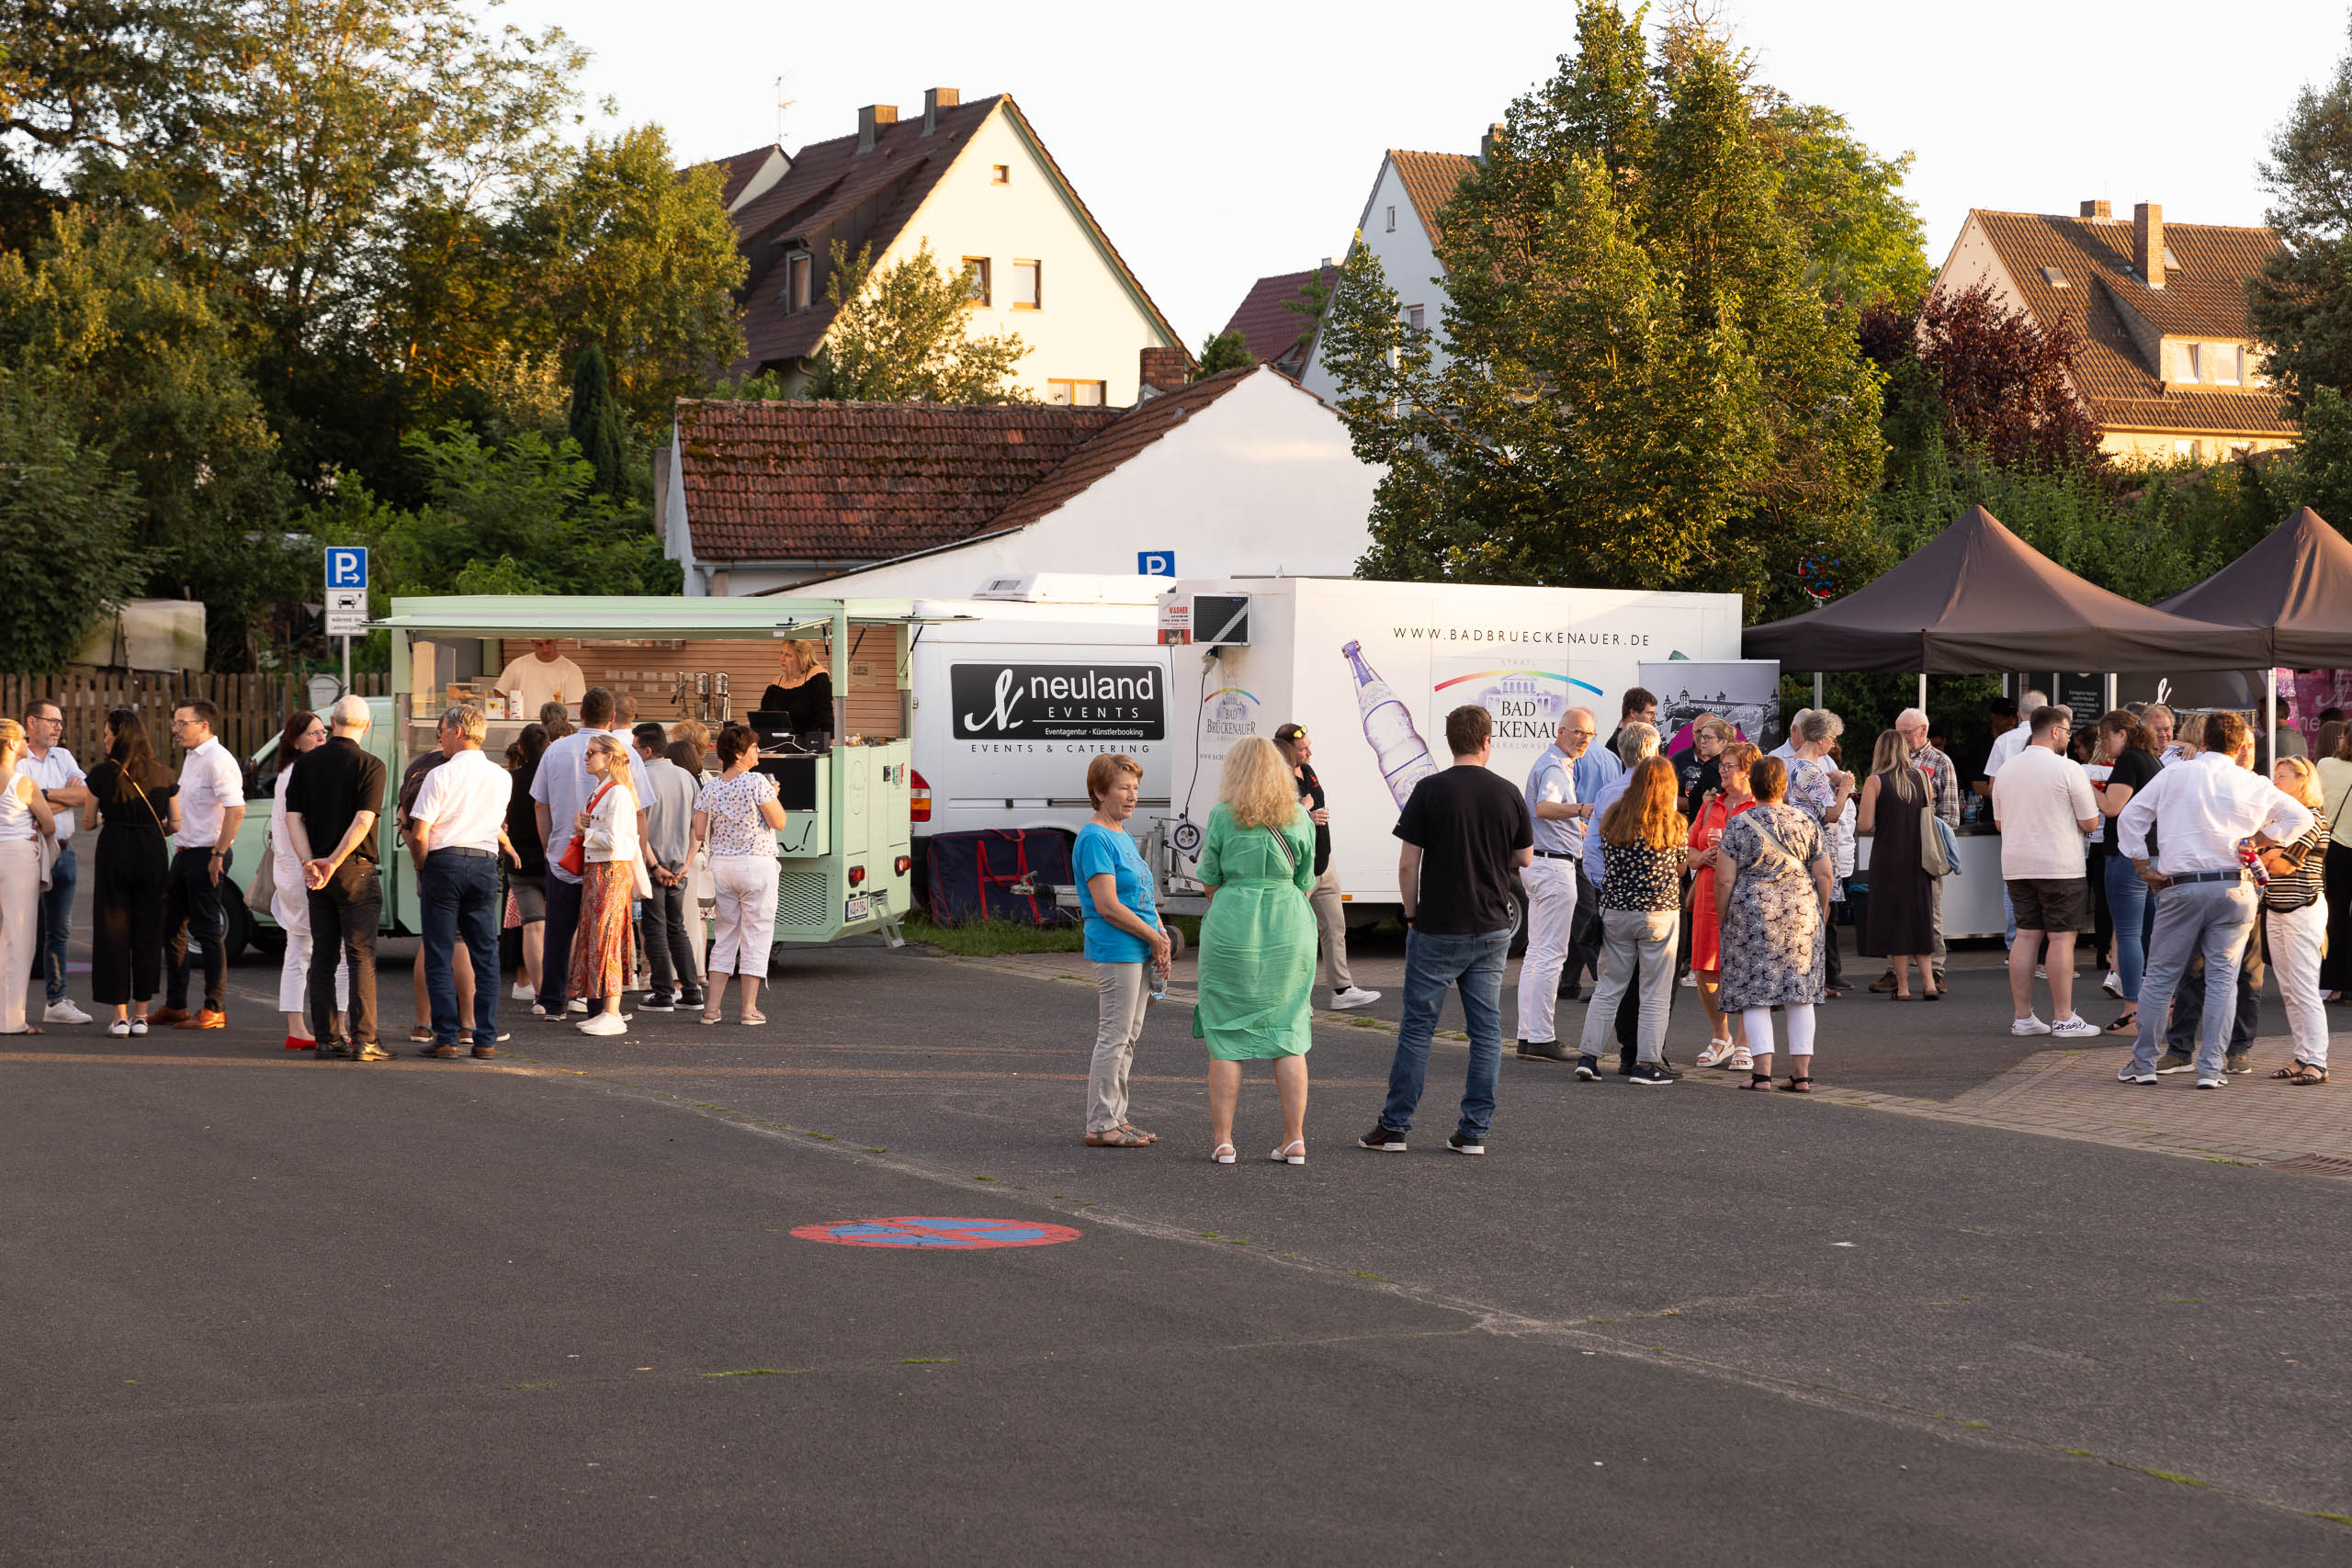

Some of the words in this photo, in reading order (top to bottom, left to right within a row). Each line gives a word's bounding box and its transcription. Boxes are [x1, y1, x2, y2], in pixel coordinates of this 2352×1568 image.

[335, 552, 358, 583] P
[1146, 555, 1167, 576] P
[1393, 627, 1649, 647] WWW.BADBRUECKENAUER.DE
[1030, 670, 1154, 700] neuland
[1048, 706, 1138, 718] EVENTS
[1501, 700, 1536, 716] BAD
[1045, 728, 1087, 737] Eventagentur
[1091, 728, 1144, 738] Künstlerbooking
[971, 744, 1033, 753] EVENTS
[1046, 744, 1053, 753] &
[1066, 744, 1149, 753] CATERING
